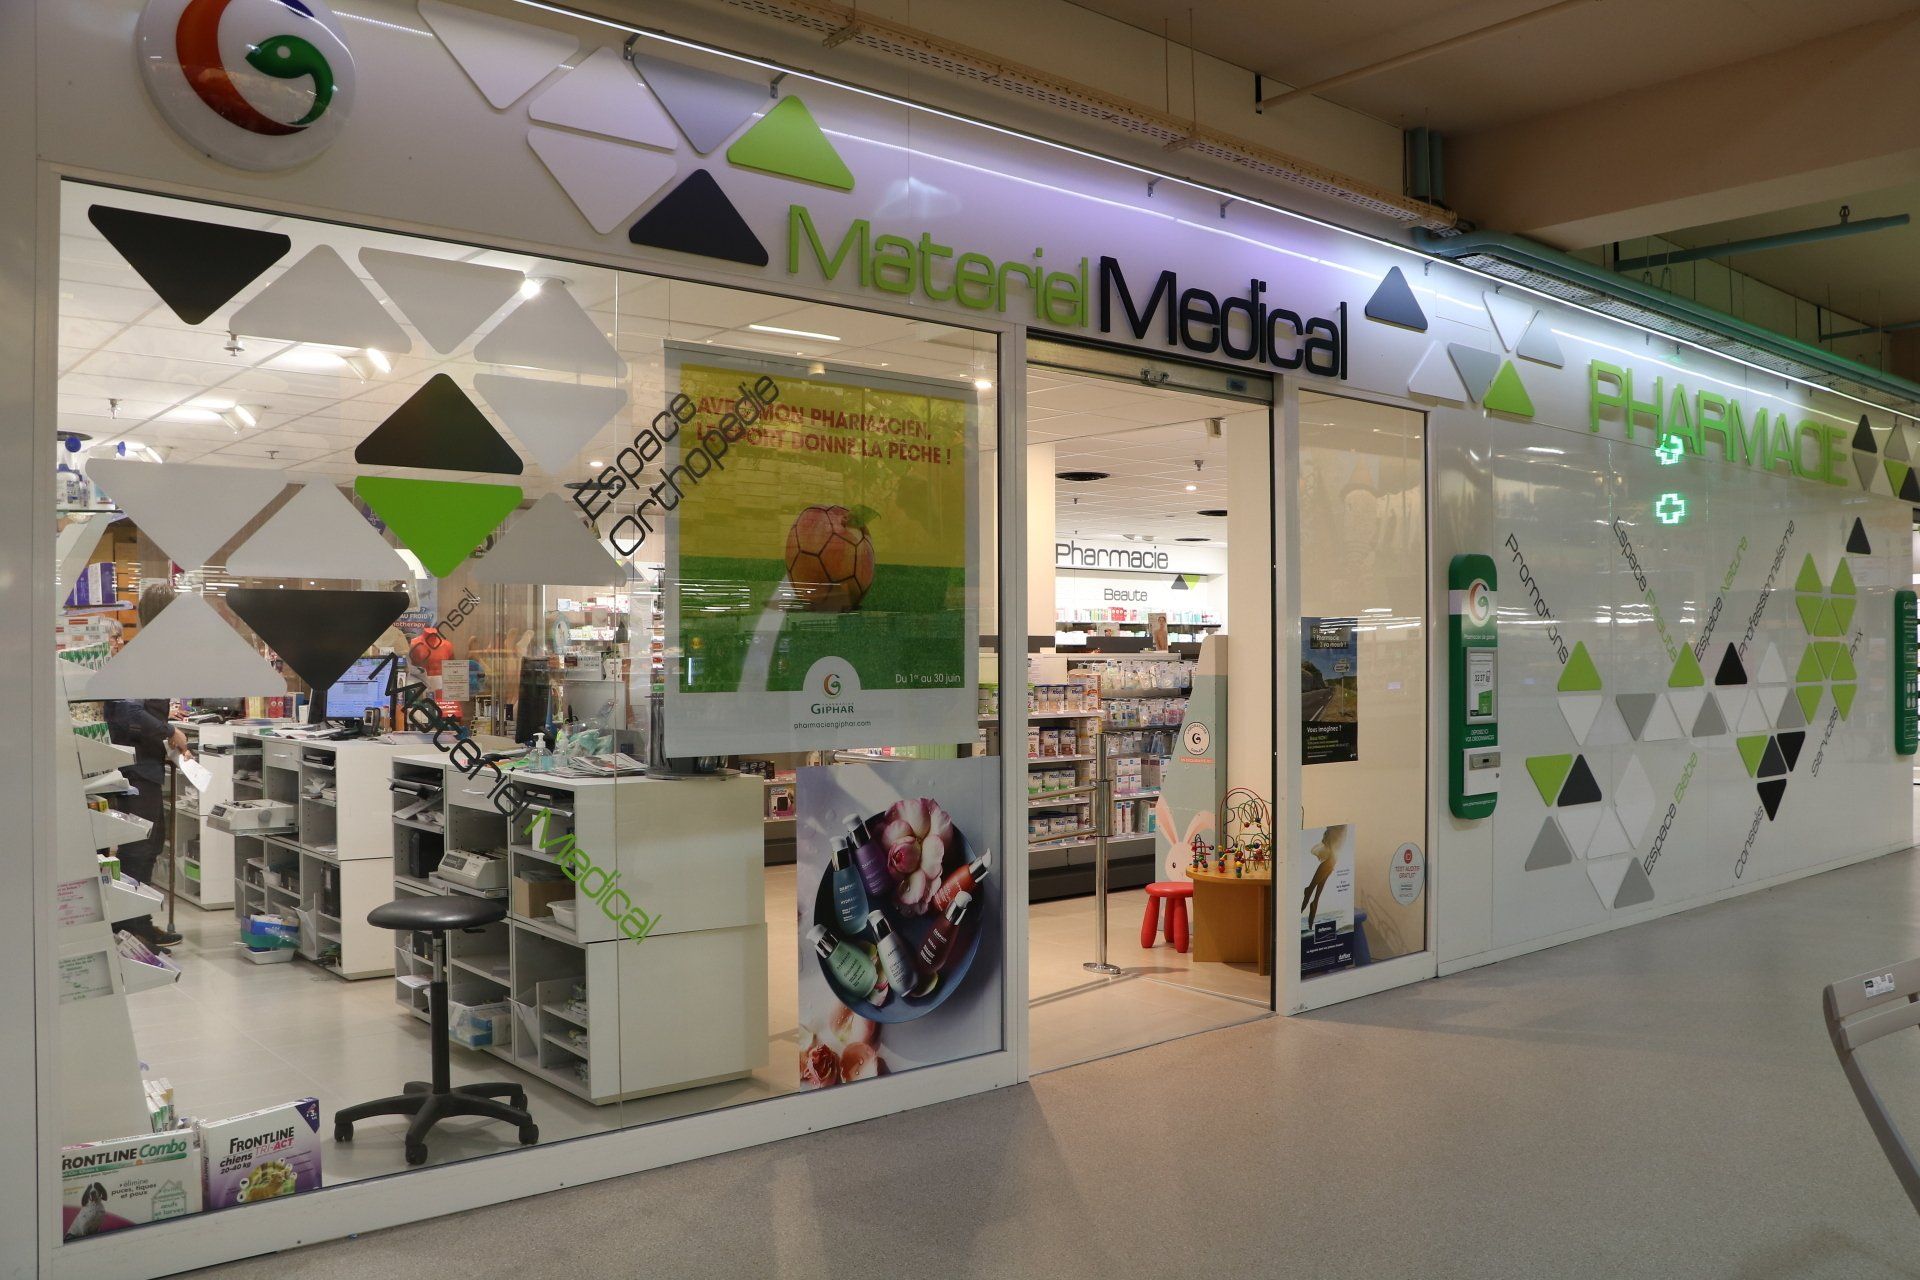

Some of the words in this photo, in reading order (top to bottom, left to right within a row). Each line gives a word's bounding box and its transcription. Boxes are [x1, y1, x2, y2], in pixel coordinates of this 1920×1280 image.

[789, 204, 1089, 328] Materiel
[1100, 255, 1347, 381] Medical
[792, 430, 856, 452] DONNE
[861, 439, 883, 459] LA
[888, 438, 941, 464] PÊCHE
[810, 407, 932, 441] PHARMACIEN,
[1588, 359, 1848, 486] PHARMACIE
[572, 393, 697, 523] Espace
[1055, 540, 1169, 569] Pharmacie
[1613, 516, 1647, 592] Espace
[1104, 588, 1148, 602] Beaute
[1505, 533, 1569, 664] Promotions
[1694, 596, 1723, 663] Espace
[895, 674, 907, 683] Du
[920, 675, 932, 683] au
[934, 673, 944, 683] 30
[945, 673, 961, 685] juin
[1812, 706, 1839, 778] Services
[368, 652, 531, 823] Materiel
[523, 808, 662, 945] Medical
[1643, 803, 1676, 876] Espace
[1674, 752, 1698, 804] Bebe
[1734, 805, 1764, 879] Conseils
[62, 1148, 137, 1171] RONTLINE
[139, 1138, 187, 1158] Combo
[219, 1152, 252, 1168] chiens
[229, 1126, 295, 1154] FRONTLINE
[255, 1138, 295, 1156] TRI-ACT
[220, 1163, 243, 1174] 20-40
[243, 1162, 251, 1170] kg
